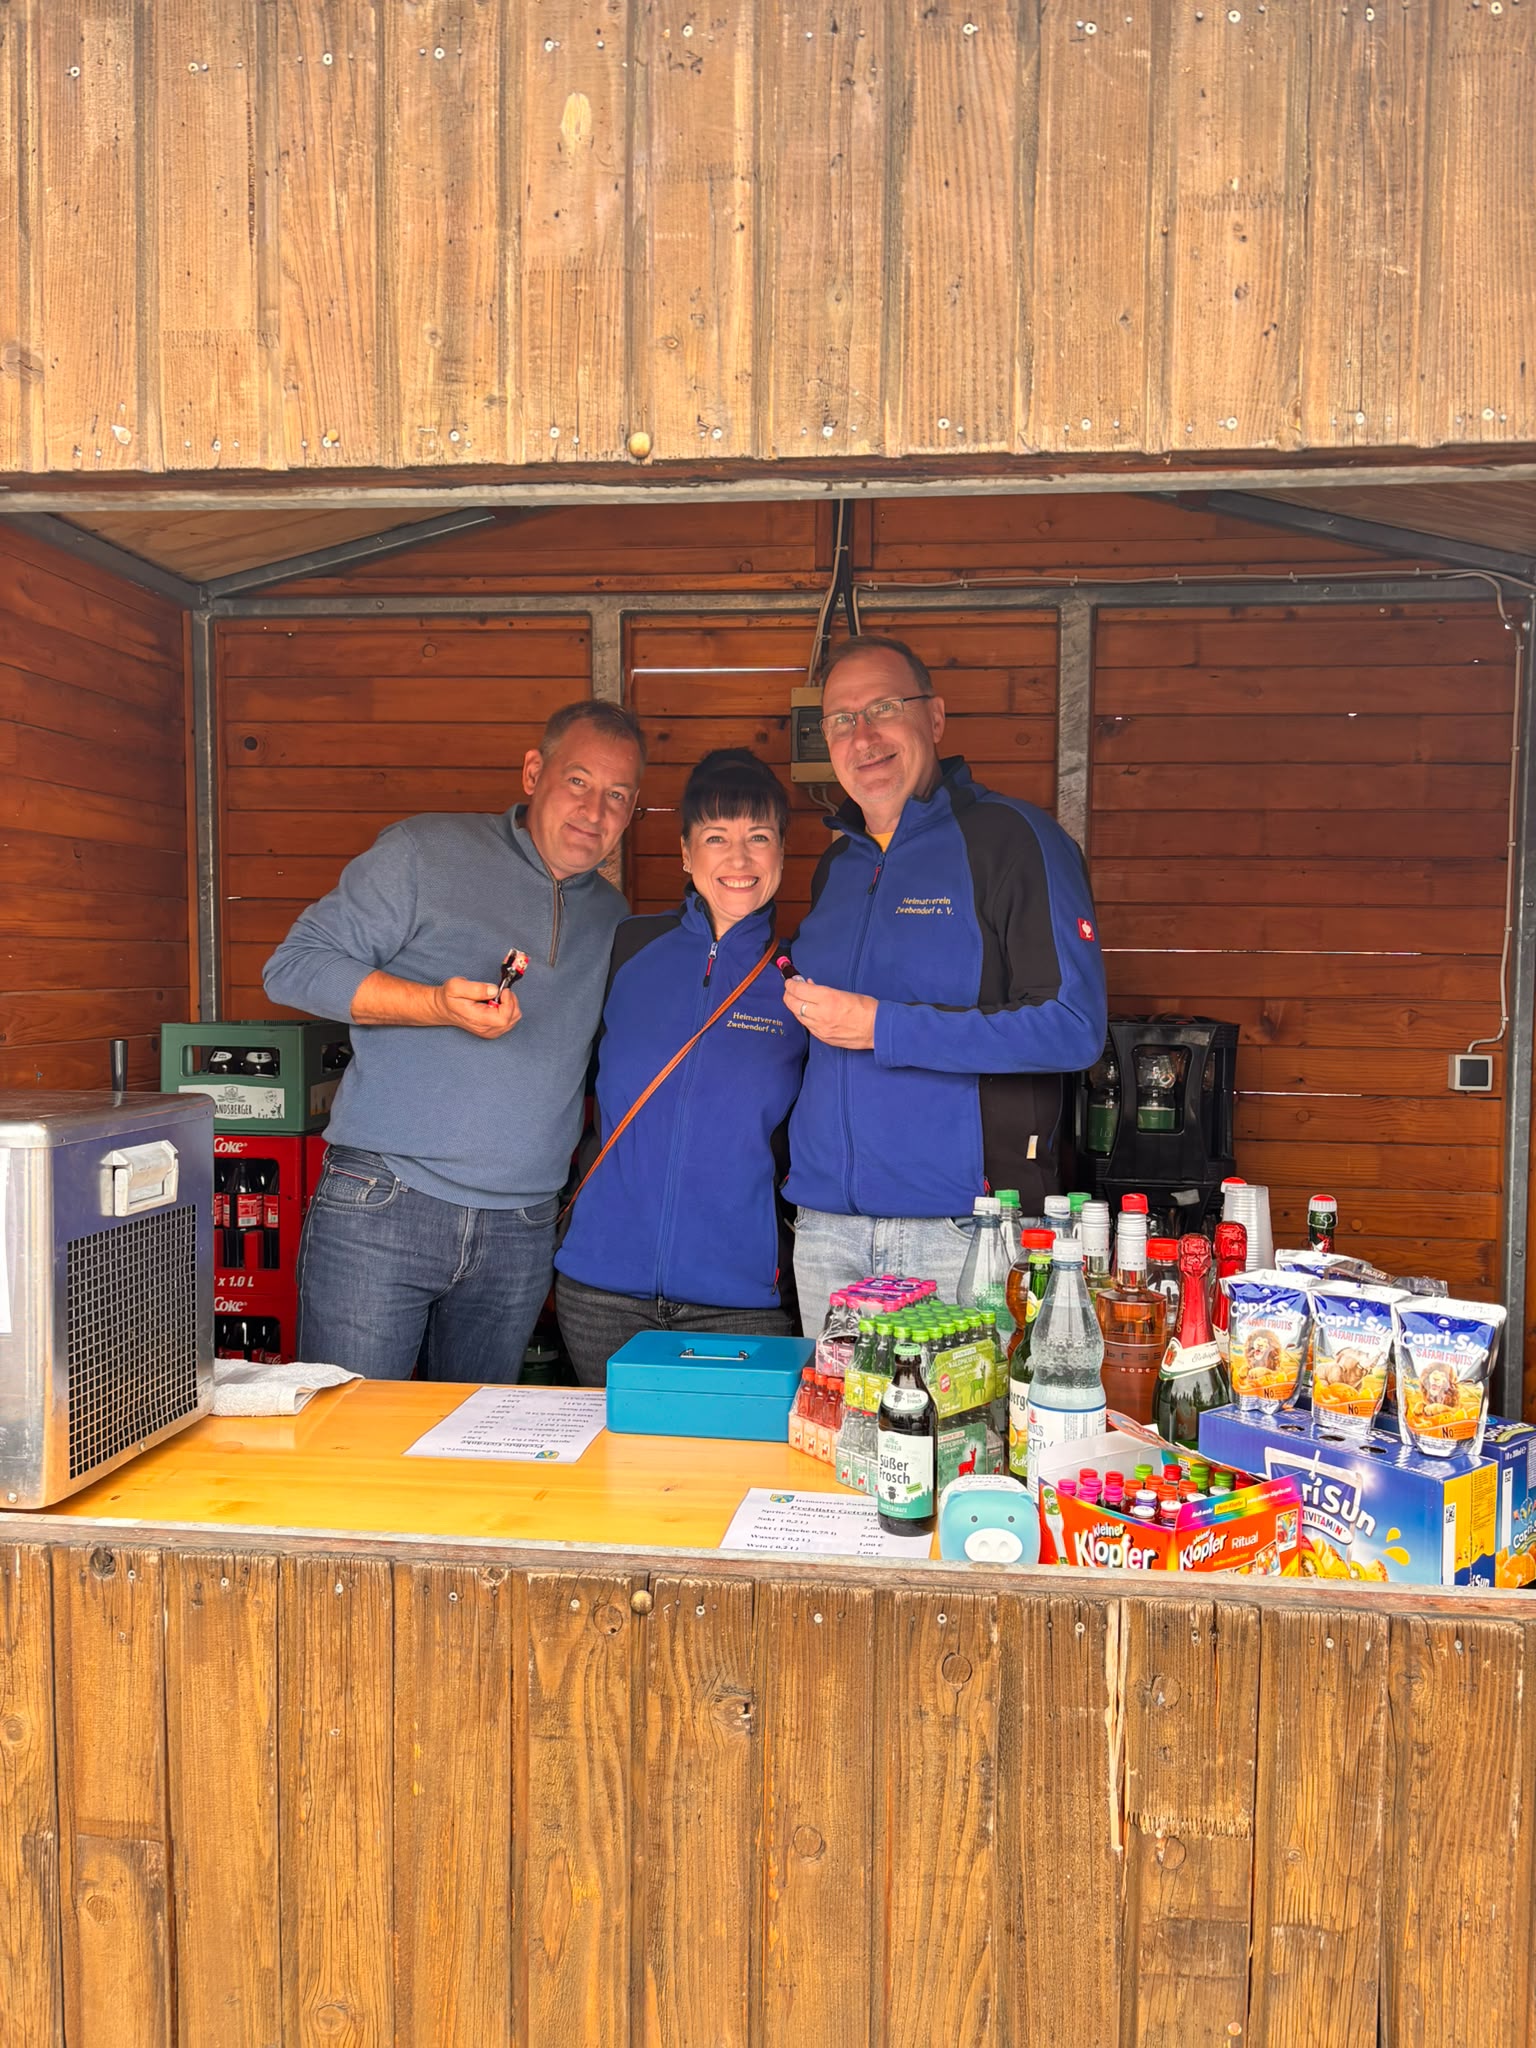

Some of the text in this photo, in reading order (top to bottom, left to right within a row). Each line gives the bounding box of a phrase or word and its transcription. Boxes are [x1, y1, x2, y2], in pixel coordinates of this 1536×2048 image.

[726, 1020, 770, 1033] Zwebendorf
[732, 1011, 783, 1027] Heimatverein
[215, 1103, 253, 1116] ANDSBERGER
[214, 1137, 244, 1153] Coke
[229, 1275, 246, 1288] 1.0
[247, 1275, 255, 1288] L
[214, 1296, 244, 1313] Coke
[1230, 1298, 1307, 1327] Capri-Sun
[1267, 1318, 1293, 1332] FRUITS
[1327, 1327, 1381, 1346] SAFARI FRUITS
[1401, 1330, 1489, 1362] Capri-Sun
[1416, 1348, 1474, 1367] SAFARI FRUITS
[879, 1454, 909, 1473] Süßer
[879, 1467, 911, 1485] Frosch
[789, 1505, 878, 1517] Preisliste Geträn
[1302, 1480, 1377, 1538] riSun
[1092, 1521, 1127, 1539] kleiner
[1303, 1509, 1344, 1537] IVITAMIN
[1231, 1530, 1259, 1550] Ritual
[1513, 1520, 1536, 1549] Capri-
[1073, 1529, 1158, 1569] Klopfer
[1179, 1532, 1229, 1571] Klopfer
